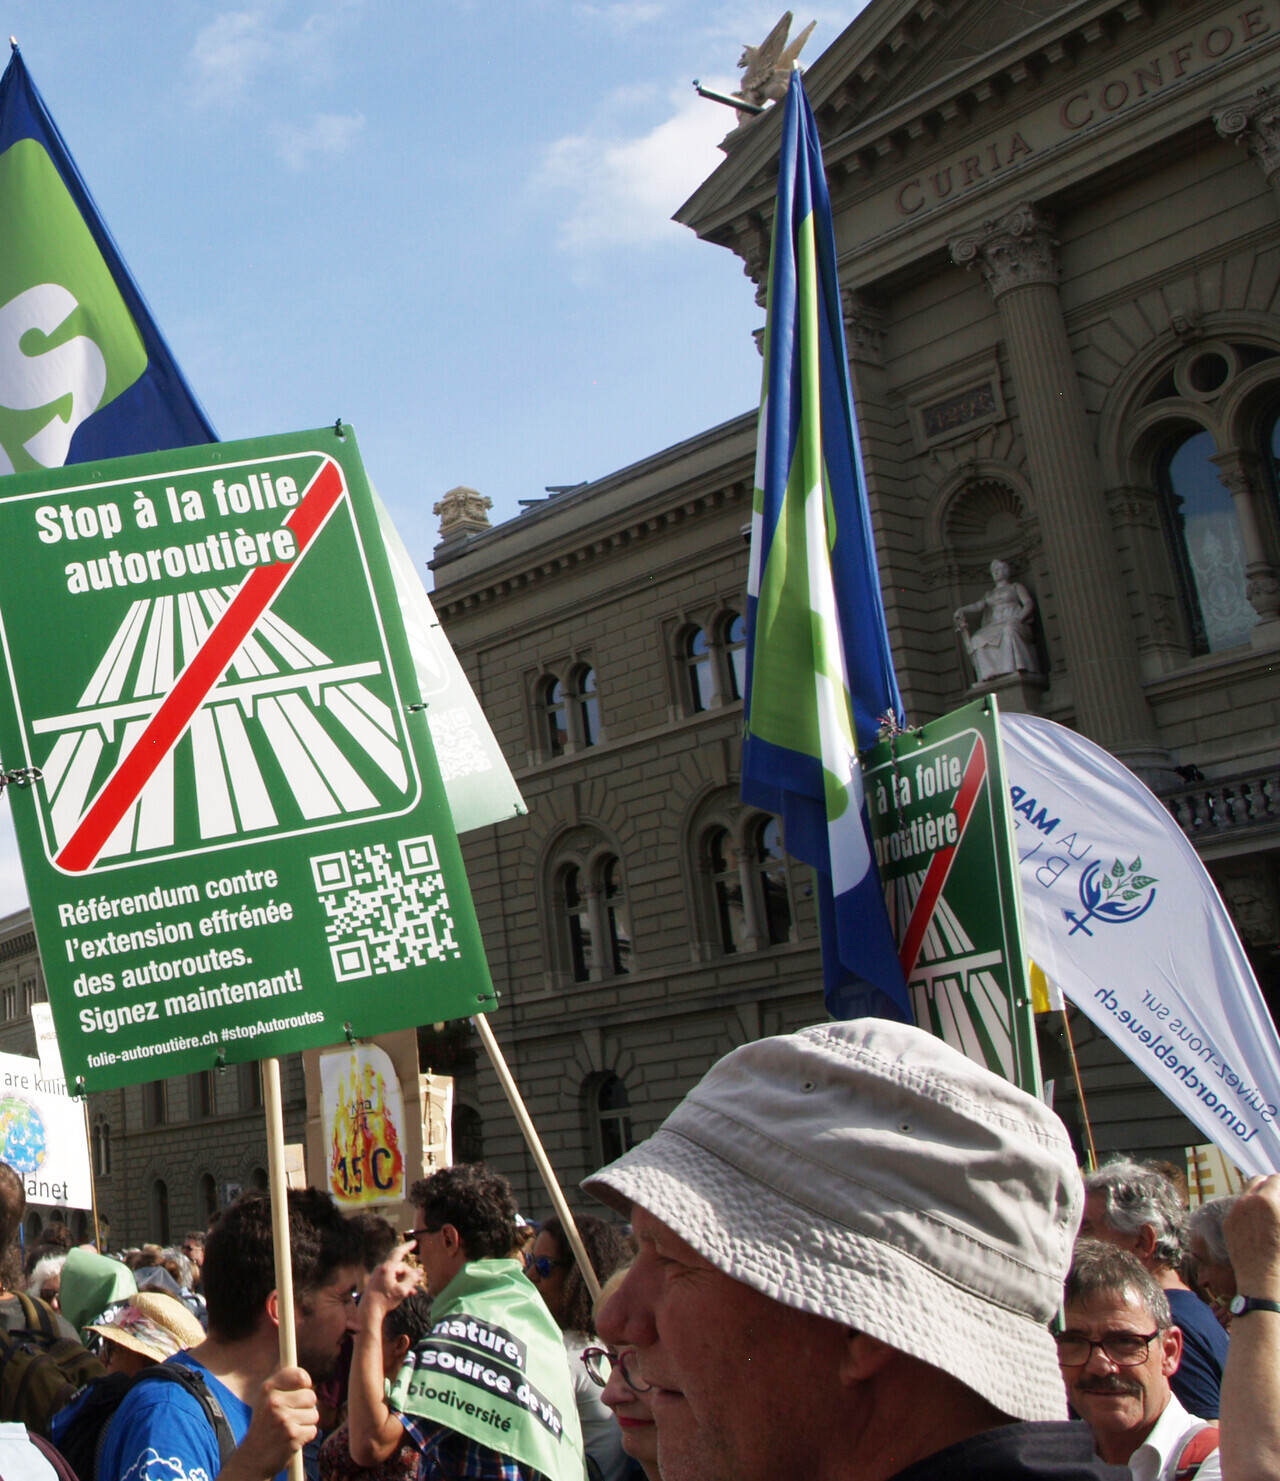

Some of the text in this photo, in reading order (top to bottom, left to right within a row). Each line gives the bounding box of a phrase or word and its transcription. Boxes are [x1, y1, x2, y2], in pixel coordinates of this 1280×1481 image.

[894, 4, 1271, 215] CURIA CONFOE
[35, 472, 299, 544] Stop à la folie
[64, 527, 297, 595] autoroutière
[876, 779, 888, 815] à
[891, 773, 912, 808] la
[916, 754, 962, 800] folie
[874, 811, 959, 866] routière
[58, 868, 278, 927] Référendum contre
[65, 899, 294, 962] l’extension effrénée
[73, 947, 253, 998] des autoroutes.
[79, 967, 303, 1034] Signez maintenant!
[87, 1009, 325, 1068] folie-autoroutière.ch #stopAutoroutes
[4, 1073, 29, 1089] are
[21, 1172, 68, 1200] lanet
[432, 1319, 522, 1368] nature,
[408, 1382, 511, 1433] biodiversité
[421, 1350, 511, 1394] source
[516, 1383, 540, 1411] de
